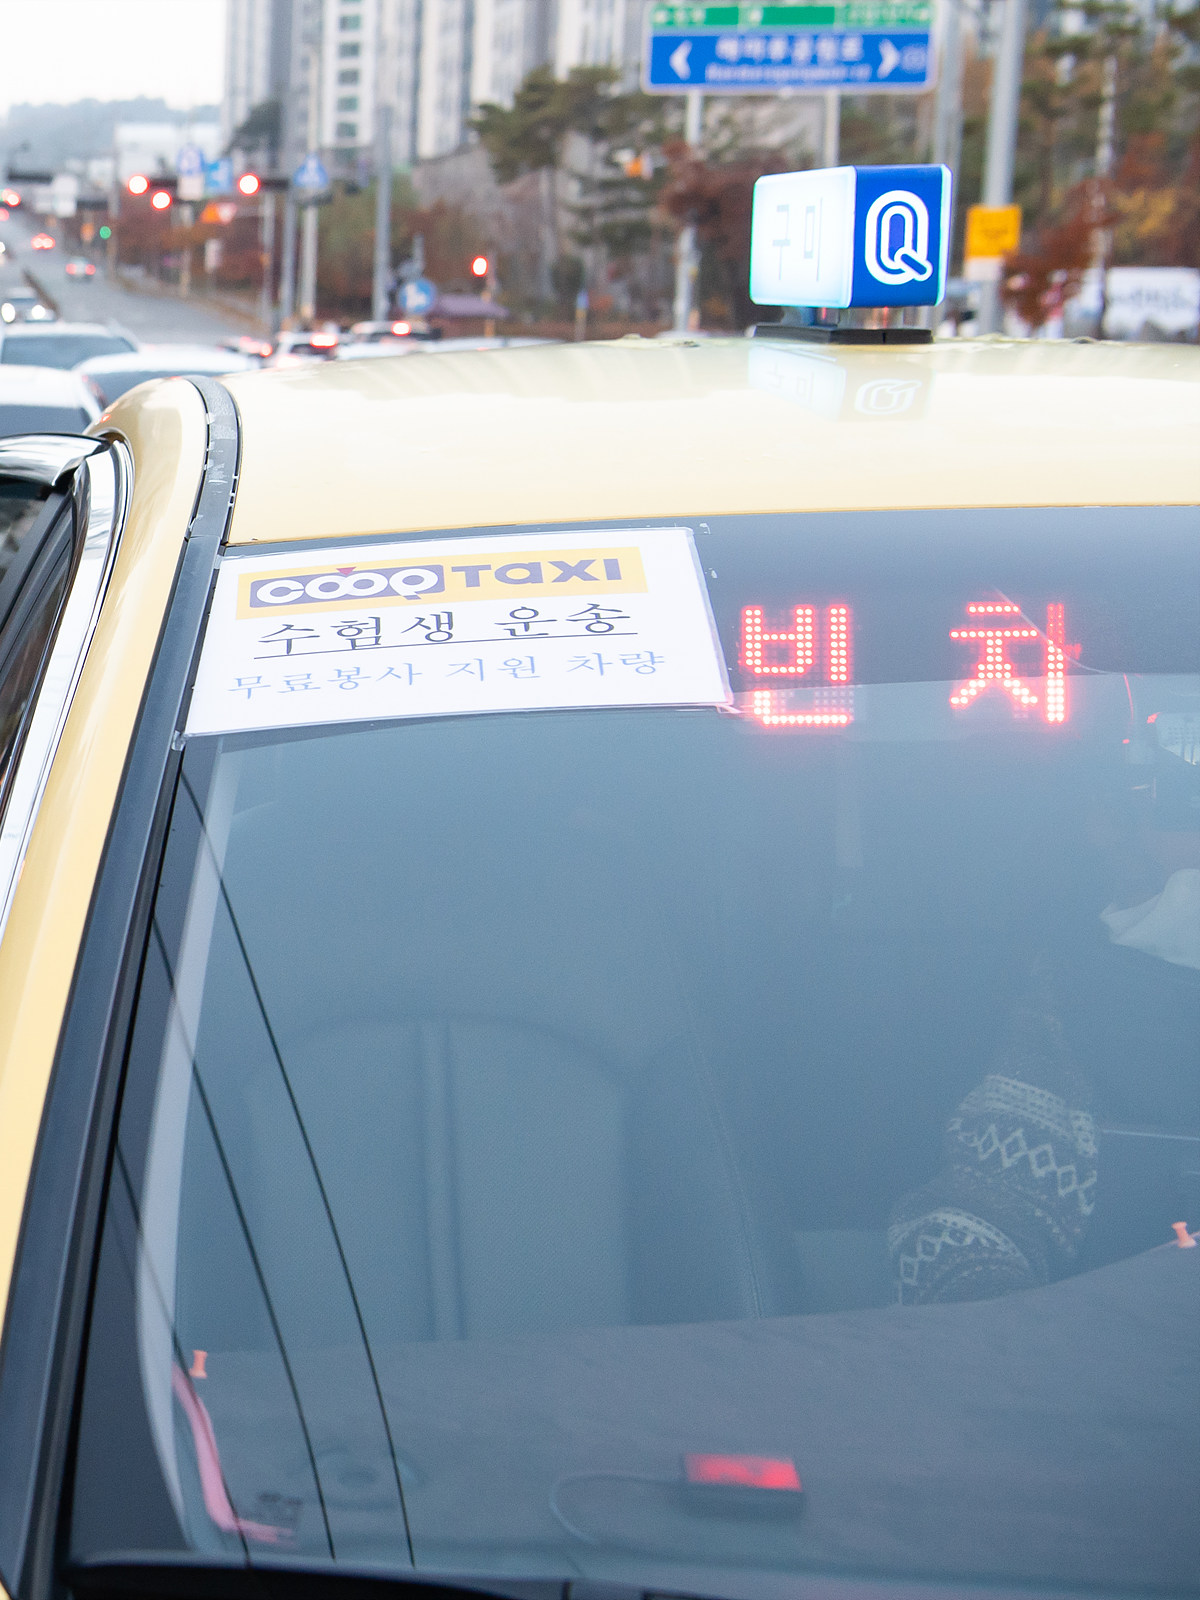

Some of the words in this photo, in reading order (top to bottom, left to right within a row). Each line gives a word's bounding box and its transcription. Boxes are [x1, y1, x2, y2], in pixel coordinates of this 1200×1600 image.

[865, 190, 933, 285] Q
[258, 611, 454, 656] 수험생
[494, 603, 632, 637] 운송
[228, 662, 423, 700] 무료봉사
[446, 655, 543, 684] 지원
[567, 650, 666, 680] 차량
